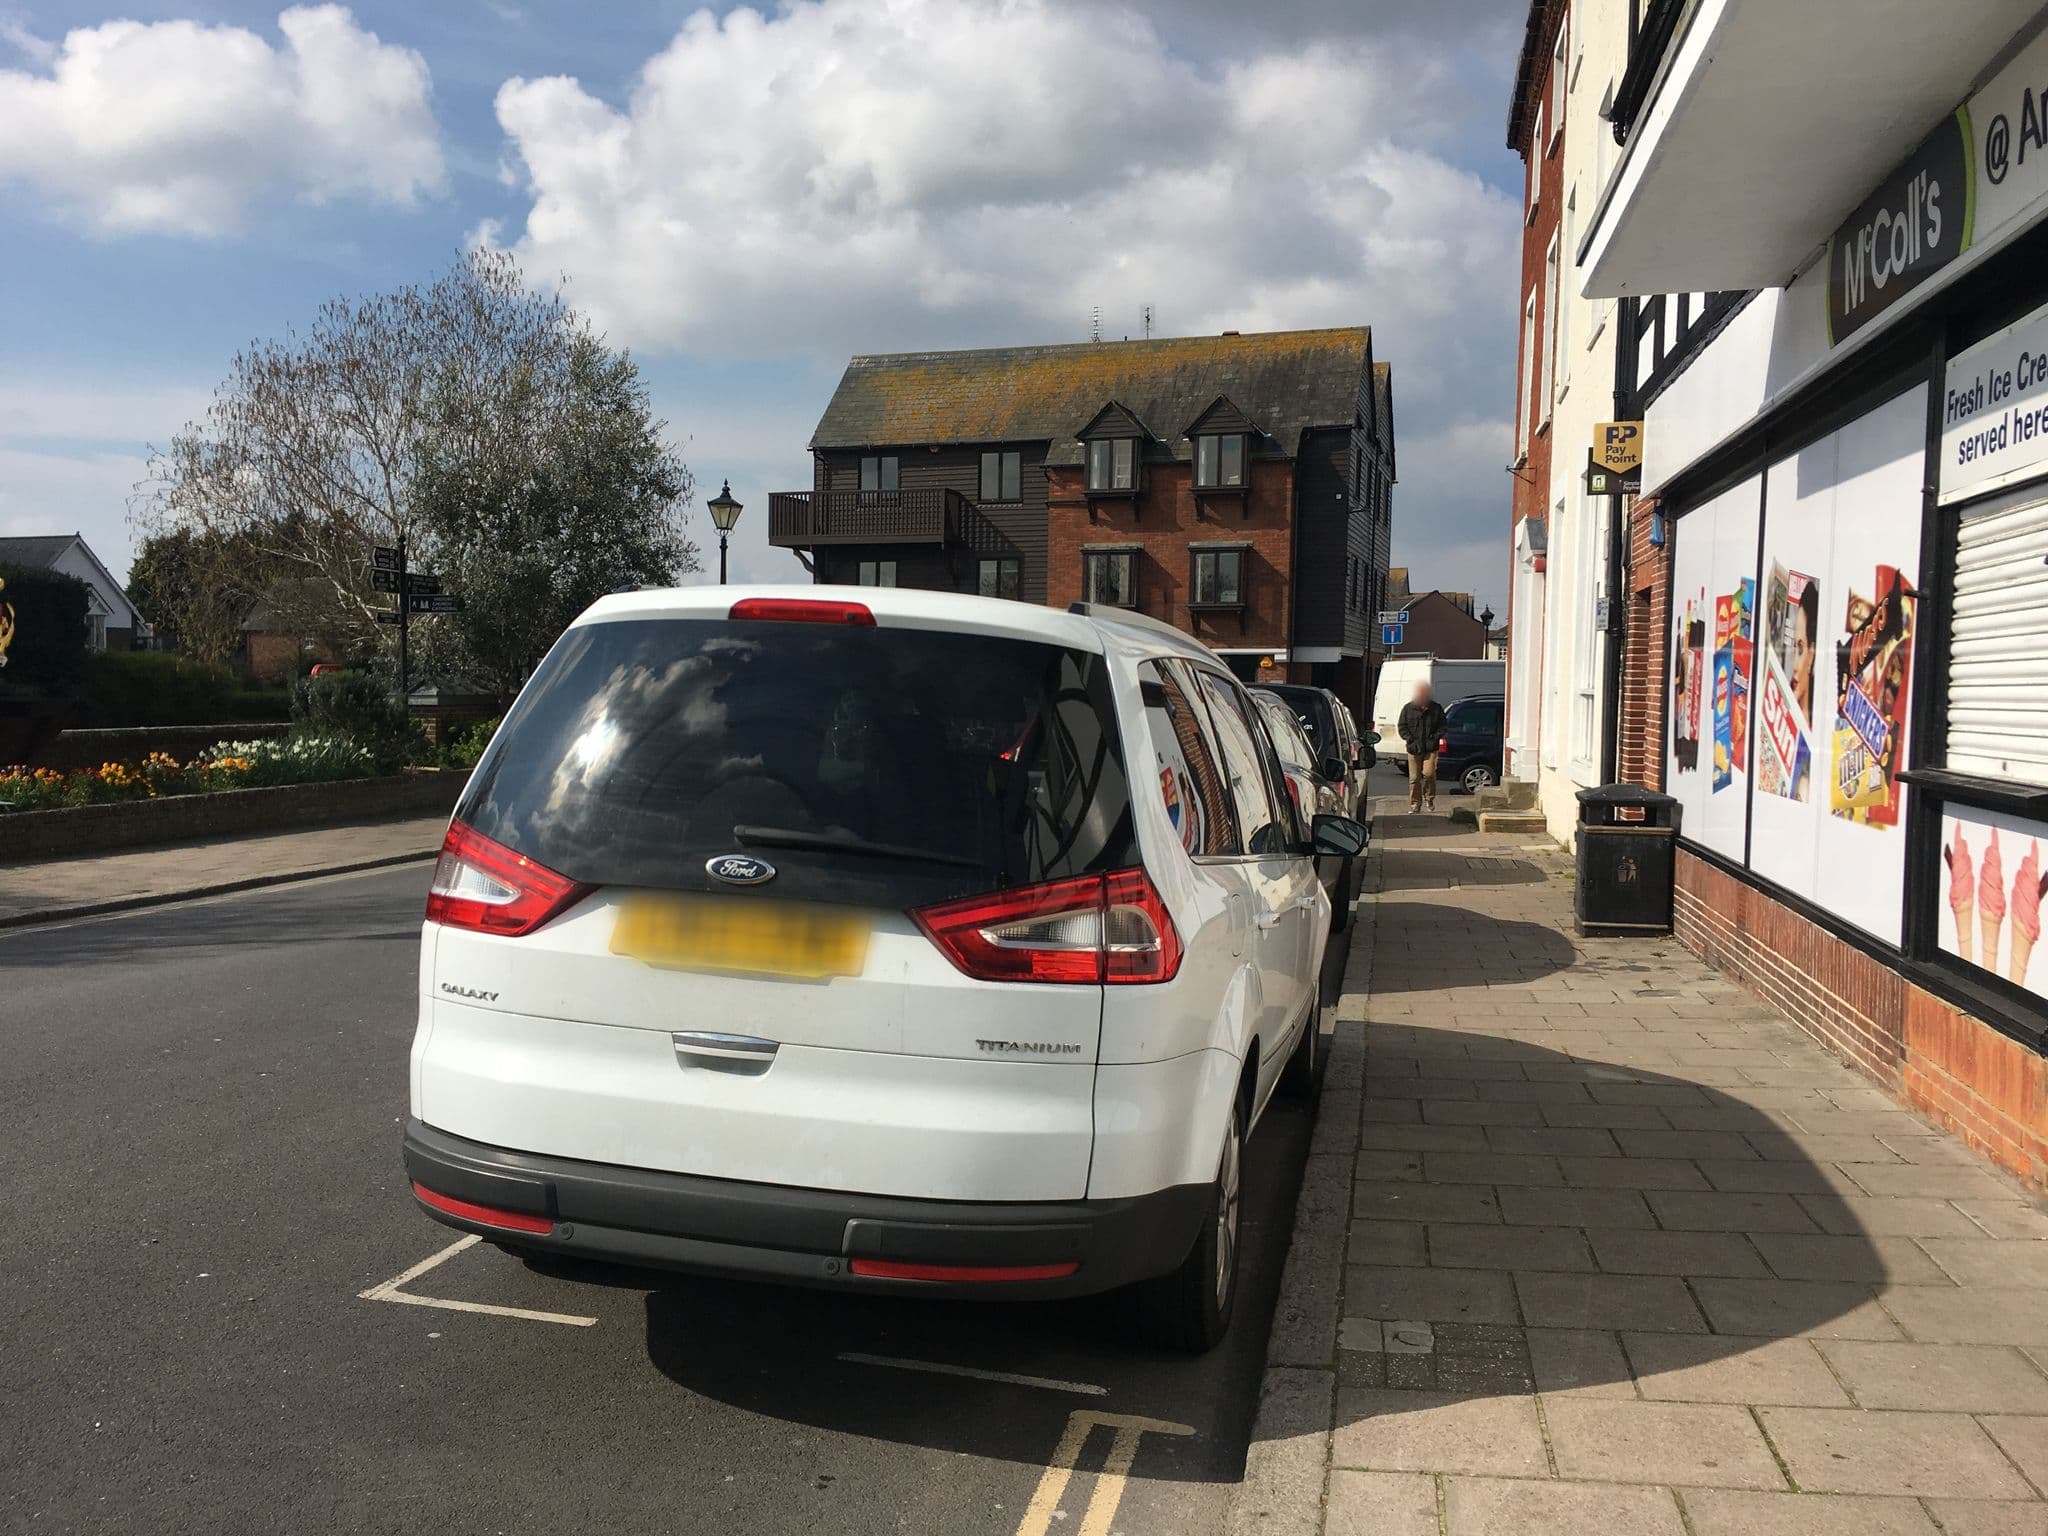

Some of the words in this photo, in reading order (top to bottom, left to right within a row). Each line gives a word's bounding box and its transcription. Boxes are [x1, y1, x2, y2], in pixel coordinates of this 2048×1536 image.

[1845, 169, 1941, 315] McColl's
[1986, 114, 2009, 185] @
[1947, 376, 1984, 424] Fresh
[1988, 369, 2012, 405] Ice
[2017, 352, 2048, 391] Cre
[1959, 412, 2009, 465] served
[1605, 454, 1637, 463] Point
[1606, 445, 1626, 455] Pay
[1764, 678, 1795, 772] Sun
[720, 860, 757, 877] Ford
[441, 982, 499, 1002] GALAXY
[976, 1039, 1081, 1053] TITANIUM
